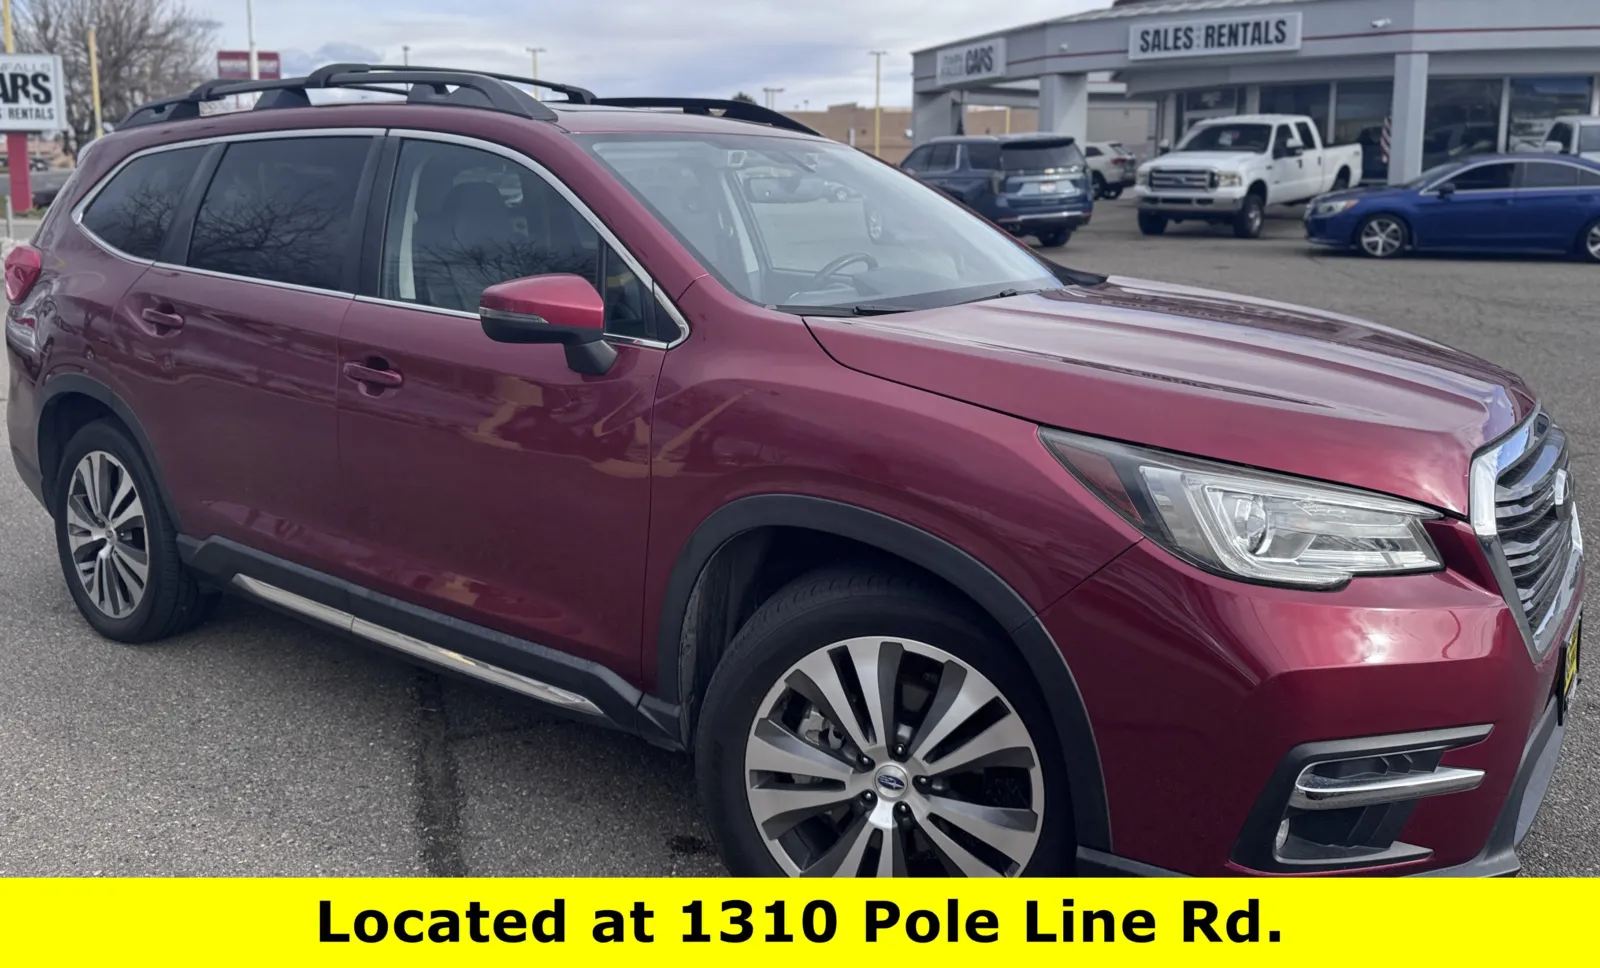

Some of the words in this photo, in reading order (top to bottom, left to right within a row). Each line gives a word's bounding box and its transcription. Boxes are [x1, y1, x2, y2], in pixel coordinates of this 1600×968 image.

[1139, 26, 1194, 53] SALES
[1204, 19, 1287, 49] RENTALS
[8, 107, 54, 120] RENTALS
